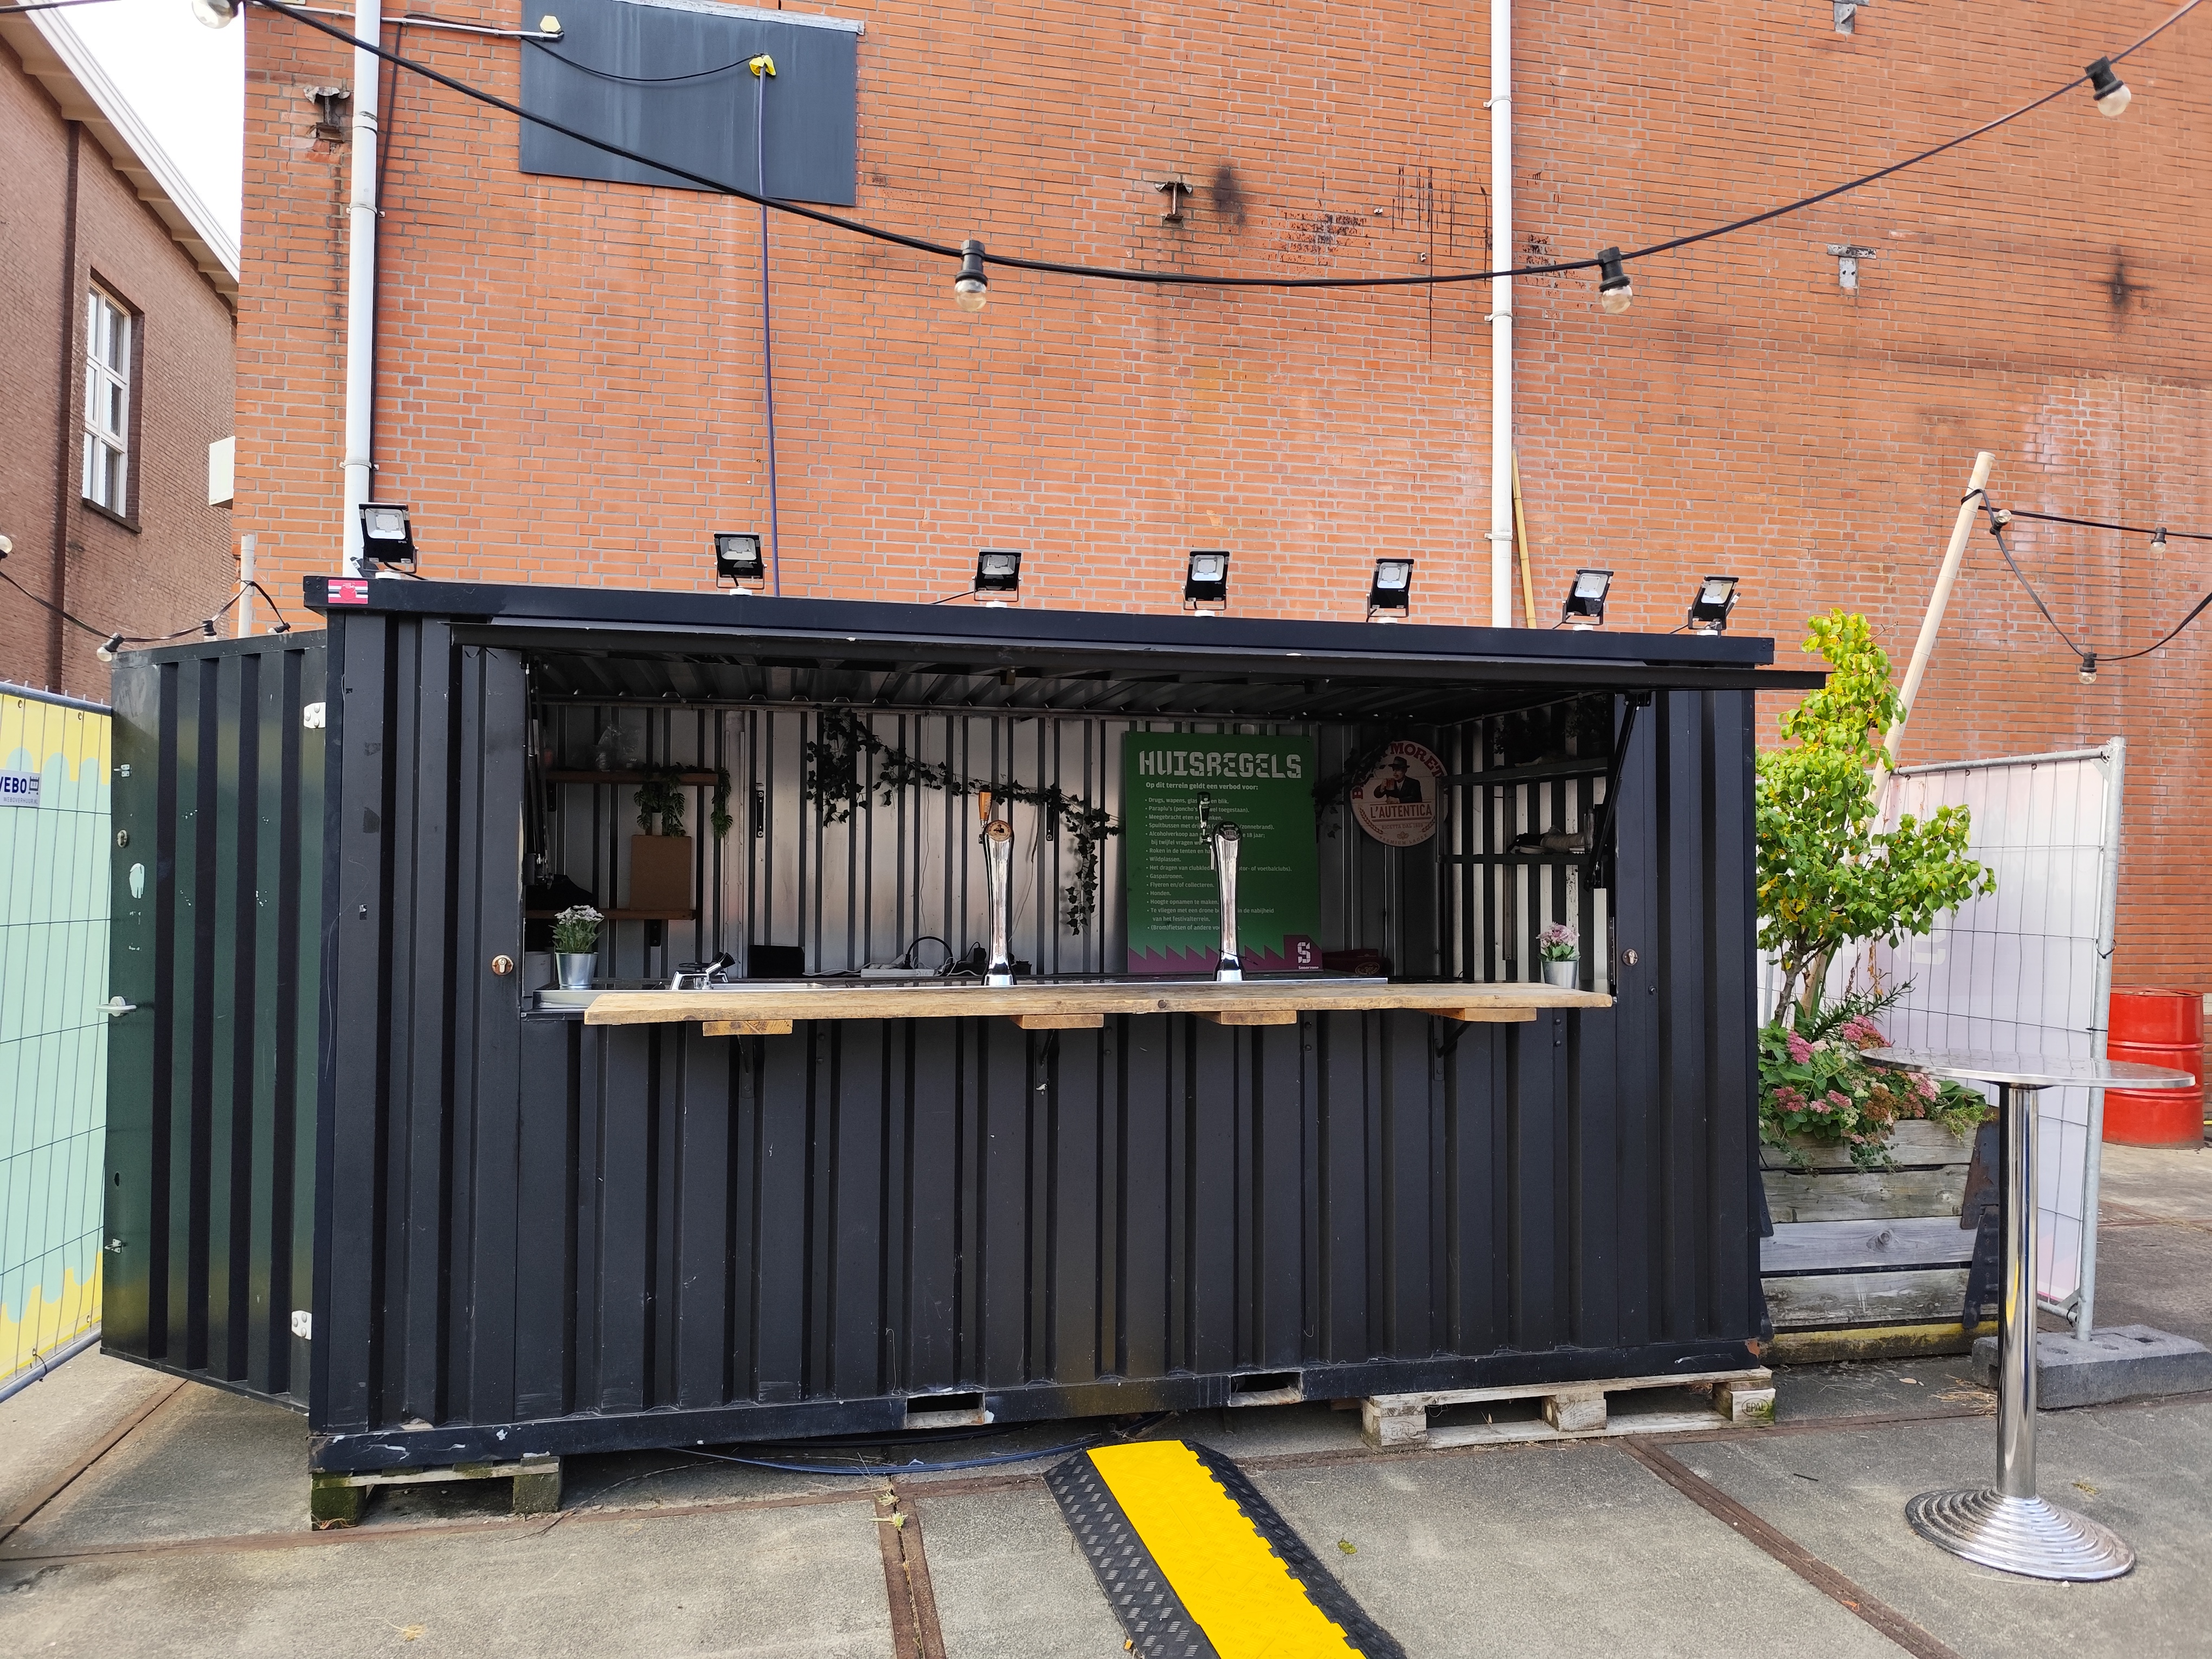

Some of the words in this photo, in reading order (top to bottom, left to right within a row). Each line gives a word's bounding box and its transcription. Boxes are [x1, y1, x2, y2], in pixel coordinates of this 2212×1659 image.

[1140, 750, 1301, 778] HUISREGELS
[1390, 743, 1445, 777] MORET
[1370, 804, 1432, 819] L'AUTENTICA
[1379, 835, 1406, 845] PREMIUM
[1746, 1402, 1765, 1412] EPAL
